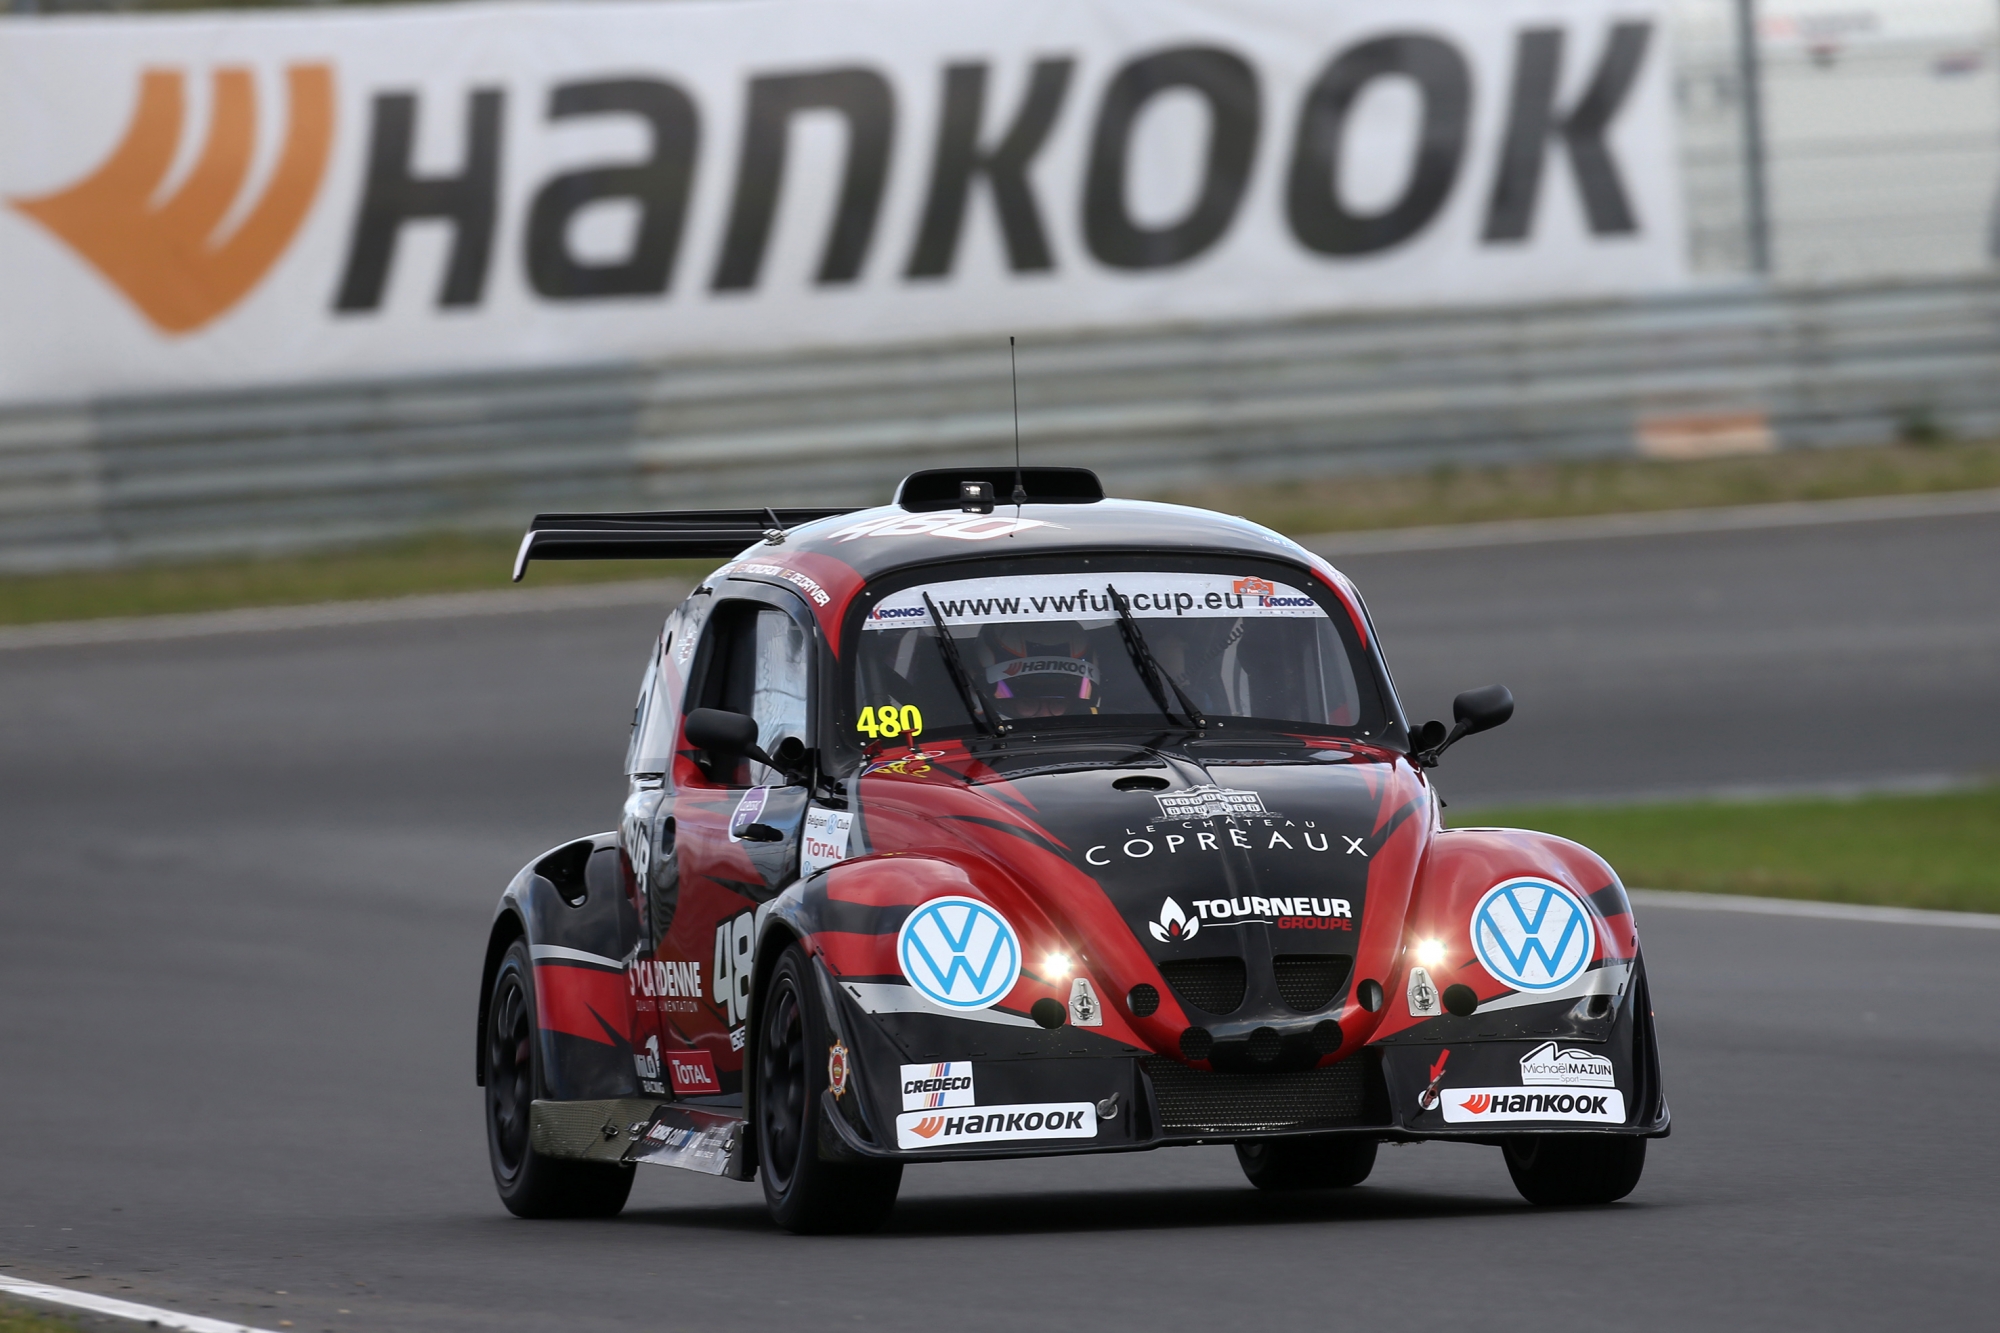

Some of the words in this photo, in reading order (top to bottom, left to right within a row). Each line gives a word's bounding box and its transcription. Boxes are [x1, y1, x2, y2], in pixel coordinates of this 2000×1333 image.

[827, 512, 1058, 543] 480
[868, 604, 925, 621] KRONOS
[938, 588, 1244, 617] www.vwfuncup.eu
[1259, 595, 1315, 608] KRONOS
[857, 705, 923, 738] 480
[807, 814, 827, 829] Belgian
[836, 818, 850, 830] Club
[1125, 824, 1156, 835] LE
[1183, 816, 1316, 830] CHÂTEAU
[806, 837, 843, 860] TOTAL
[1085, 828, 1369, 866] COPREAUX
[1192, 896, 1353, 919] TOURNEUR
[1277, 916, 1353, 931] GROUPE
[713, 898, 774, 1027] 48
[672, 1059, 712, 1085] TOTAL
[1560, 1074, 1580, 1084] Sport
[904, 1076, 971, 1095] CREDECO
